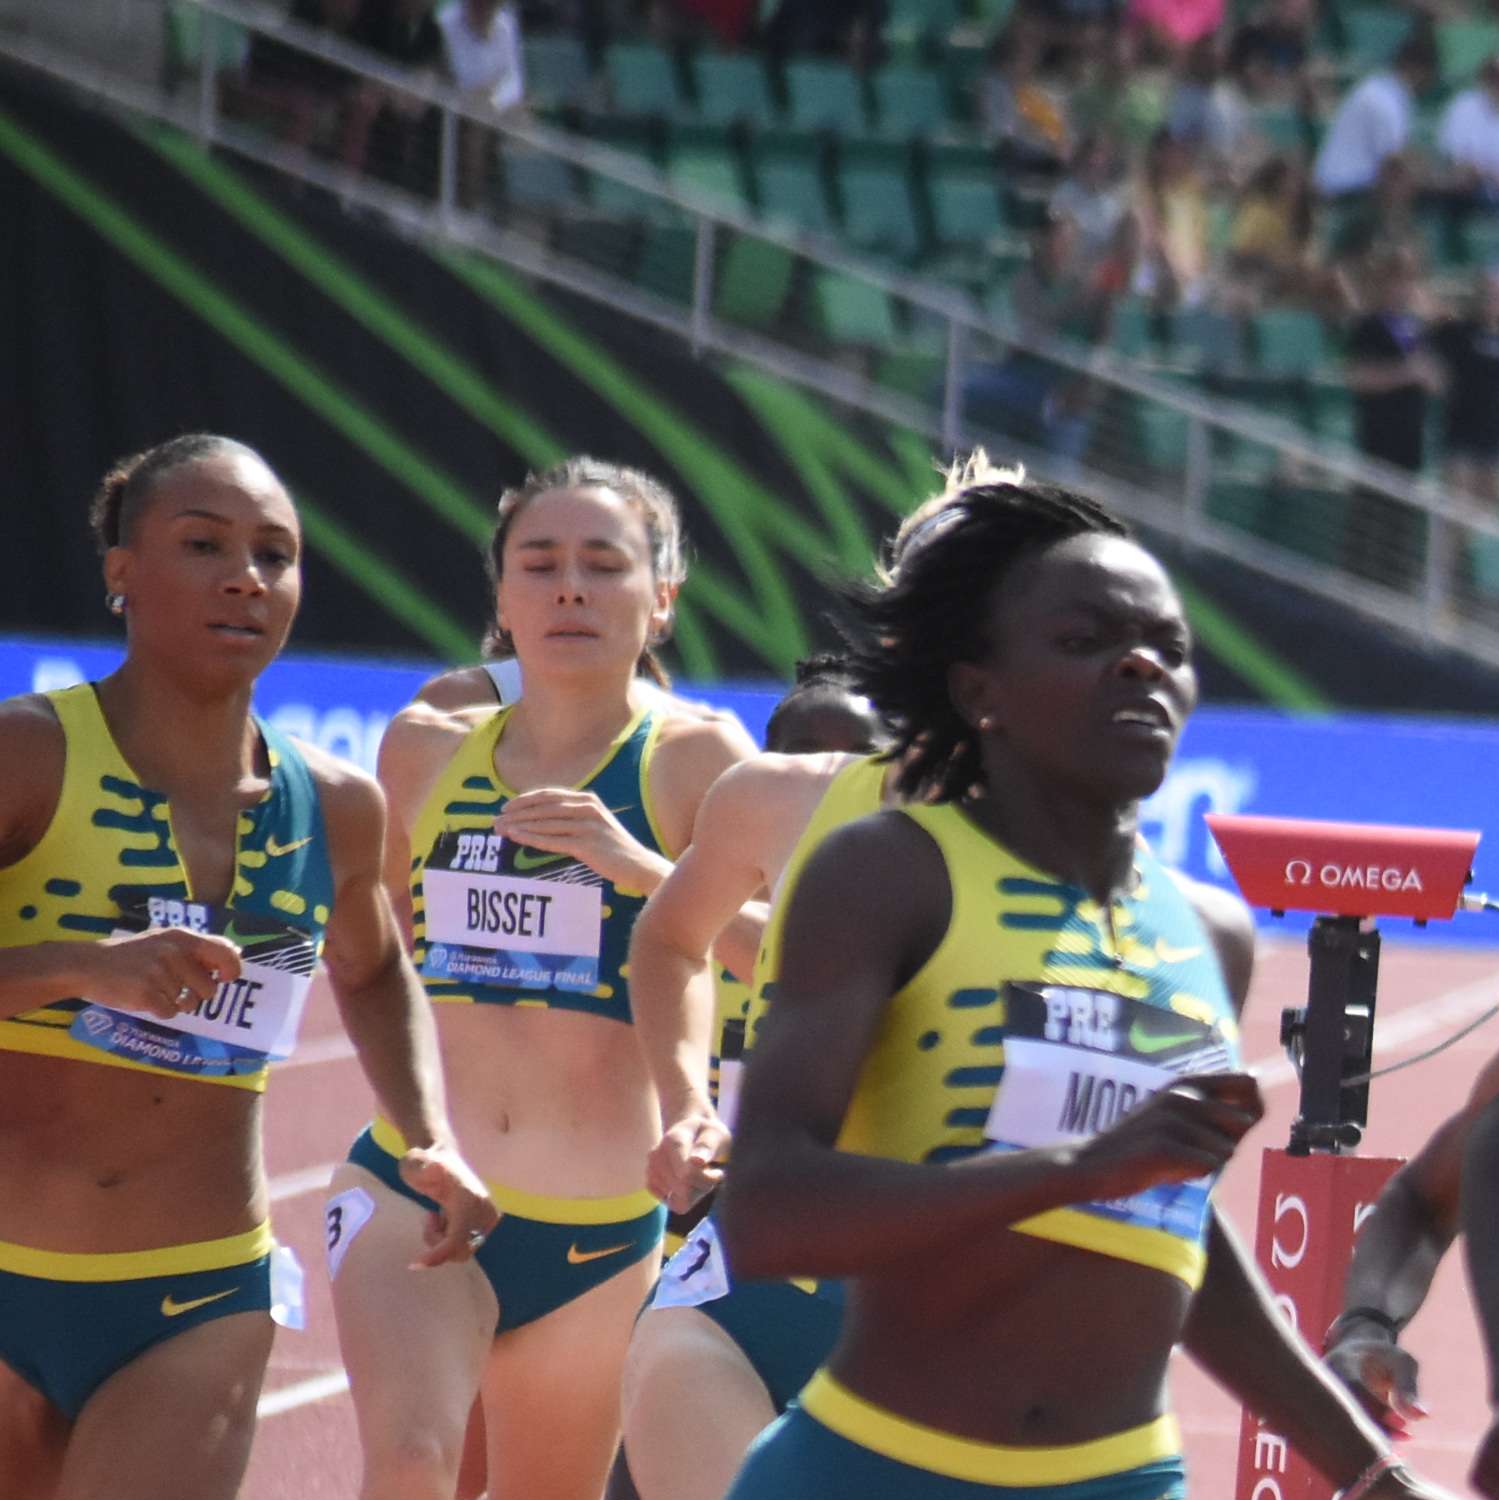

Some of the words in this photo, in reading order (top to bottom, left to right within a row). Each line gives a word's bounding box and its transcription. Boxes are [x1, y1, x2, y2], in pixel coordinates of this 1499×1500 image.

[450, 834, 502, 872] PRE
[1320, 863, 1423, 893] OMEGA
[467, 888, 552, 938] BISSET
[447, 962, 500, 978] DIAMOND
[1041, 986, 1119, 1052] PRE
[1057, 1071, 1157, 1134] MOR
